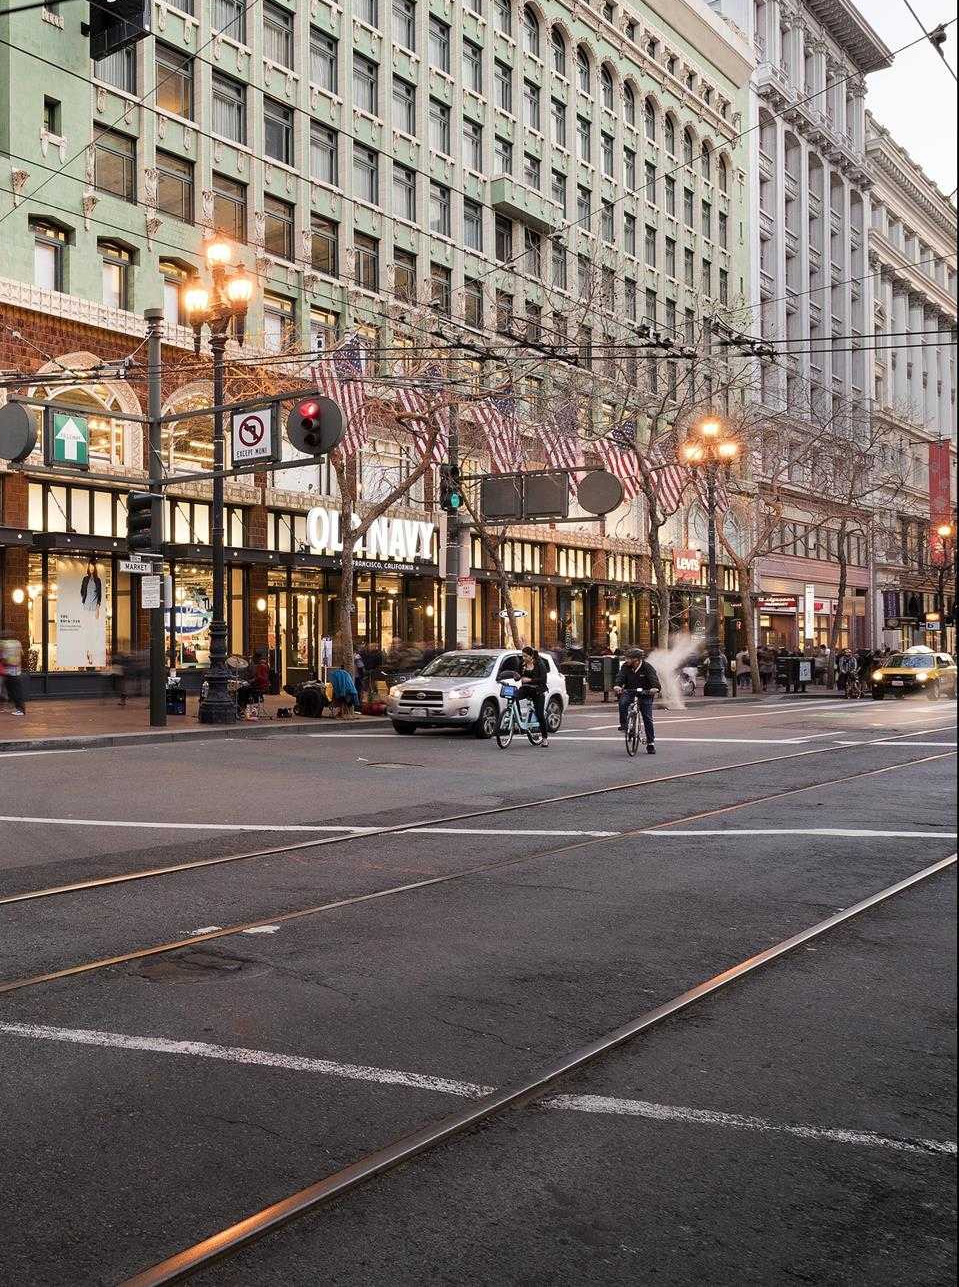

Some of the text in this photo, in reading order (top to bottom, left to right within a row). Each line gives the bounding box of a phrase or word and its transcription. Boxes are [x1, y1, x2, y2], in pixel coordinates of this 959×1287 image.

[367, 516, 435, 560] NAVY
[125, 563, 147, 571] MARKET
[384, 562, 414, 570] CALIFORNIA
